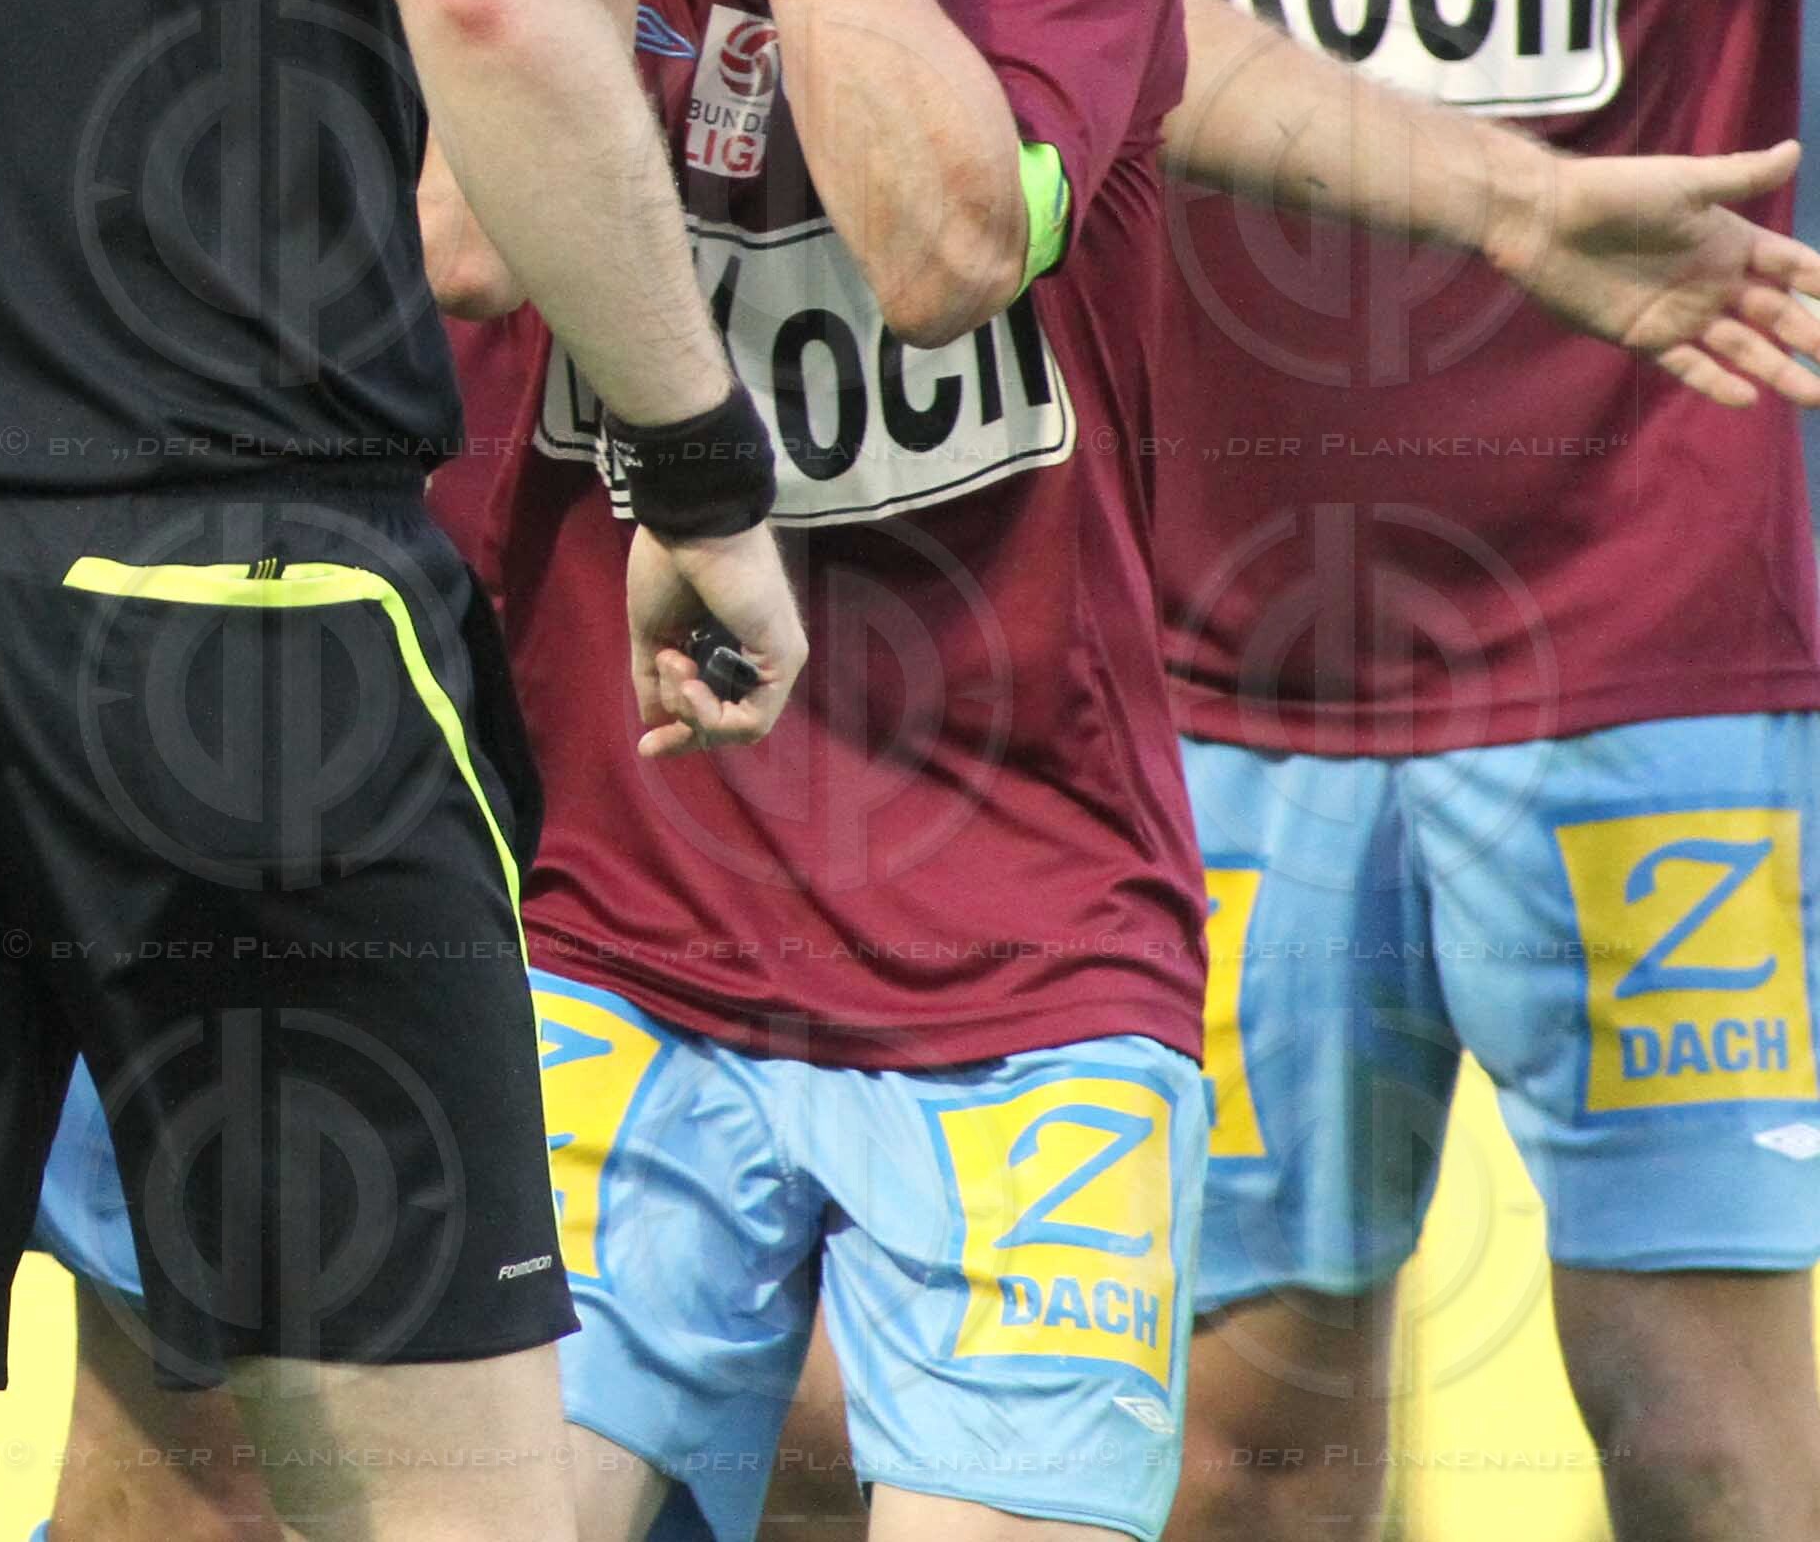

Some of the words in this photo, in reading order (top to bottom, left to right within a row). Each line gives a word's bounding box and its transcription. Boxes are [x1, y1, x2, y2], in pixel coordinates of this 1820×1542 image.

[687, 98, 769, 135] BUND
[685, 121, 764, 172] LIG
[1618, 1018, 1789, 1082] DACH
[999, 1274, 1160, 1349] DACH
